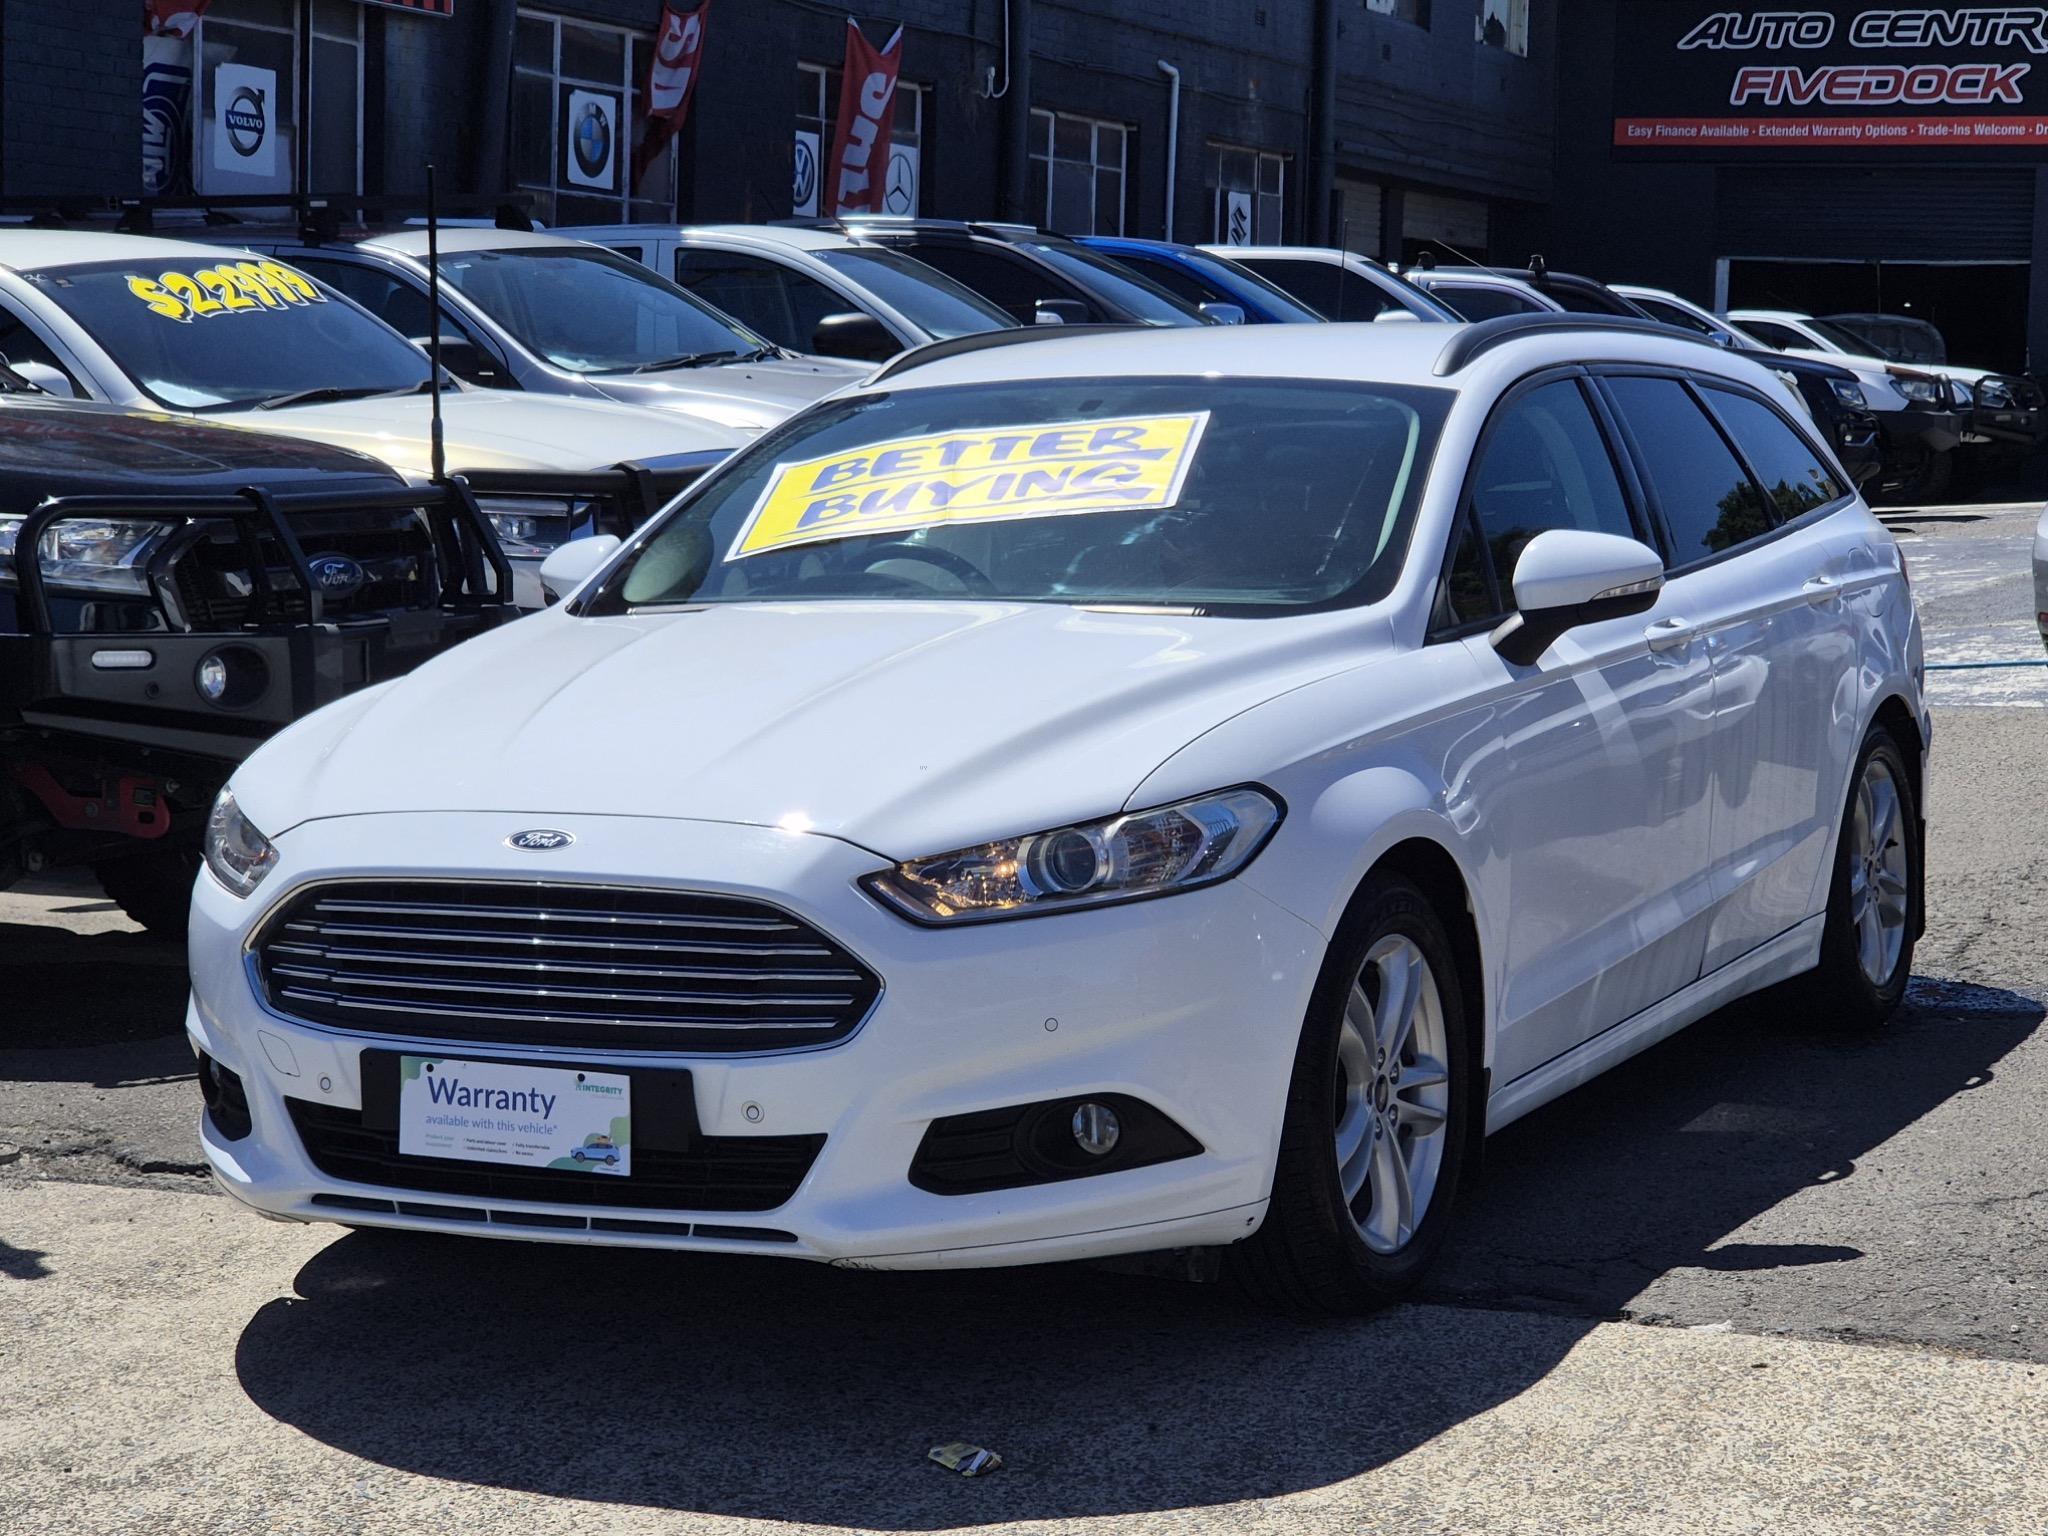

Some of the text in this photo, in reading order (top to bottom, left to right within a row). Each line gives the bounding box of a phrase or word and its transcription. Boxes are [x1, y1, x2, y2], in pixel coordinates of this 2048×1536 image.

[1677, 8, 2048, 53] AUTO CENTR
[1730, 64, 2031, 106] FIVEDOCK
[228, 113, 262, 129] VOLVO
[1628, 124, 1652, 138] Easy
[1656, 124, 1697, 137] Finance
[1700, 124, 1749, 137] Available
[1759, 124, 1808, 137] Extended
[1812, 123, 1861, 138] Warranty
[1865, 124, 1907, 138] Options
[1918, 123, 1970, 136] Trade-Ins
[1974, 123, 2025, 136] Welcome
[124, 261, 328, 323] $22999
[809, 425, 1148, 492] BETTER
[796, 461, 1142, 529] BUYING
[518, 832, 562, 847] Ford
[427, 1076, 556, 1120] Warranty
[582, 1084, 623, 1095] INTEGRITY
[425, 1115, 469, 1128] available
[472, 1119, 494, 1130] with
[497, 1120, 515, 1132] this
